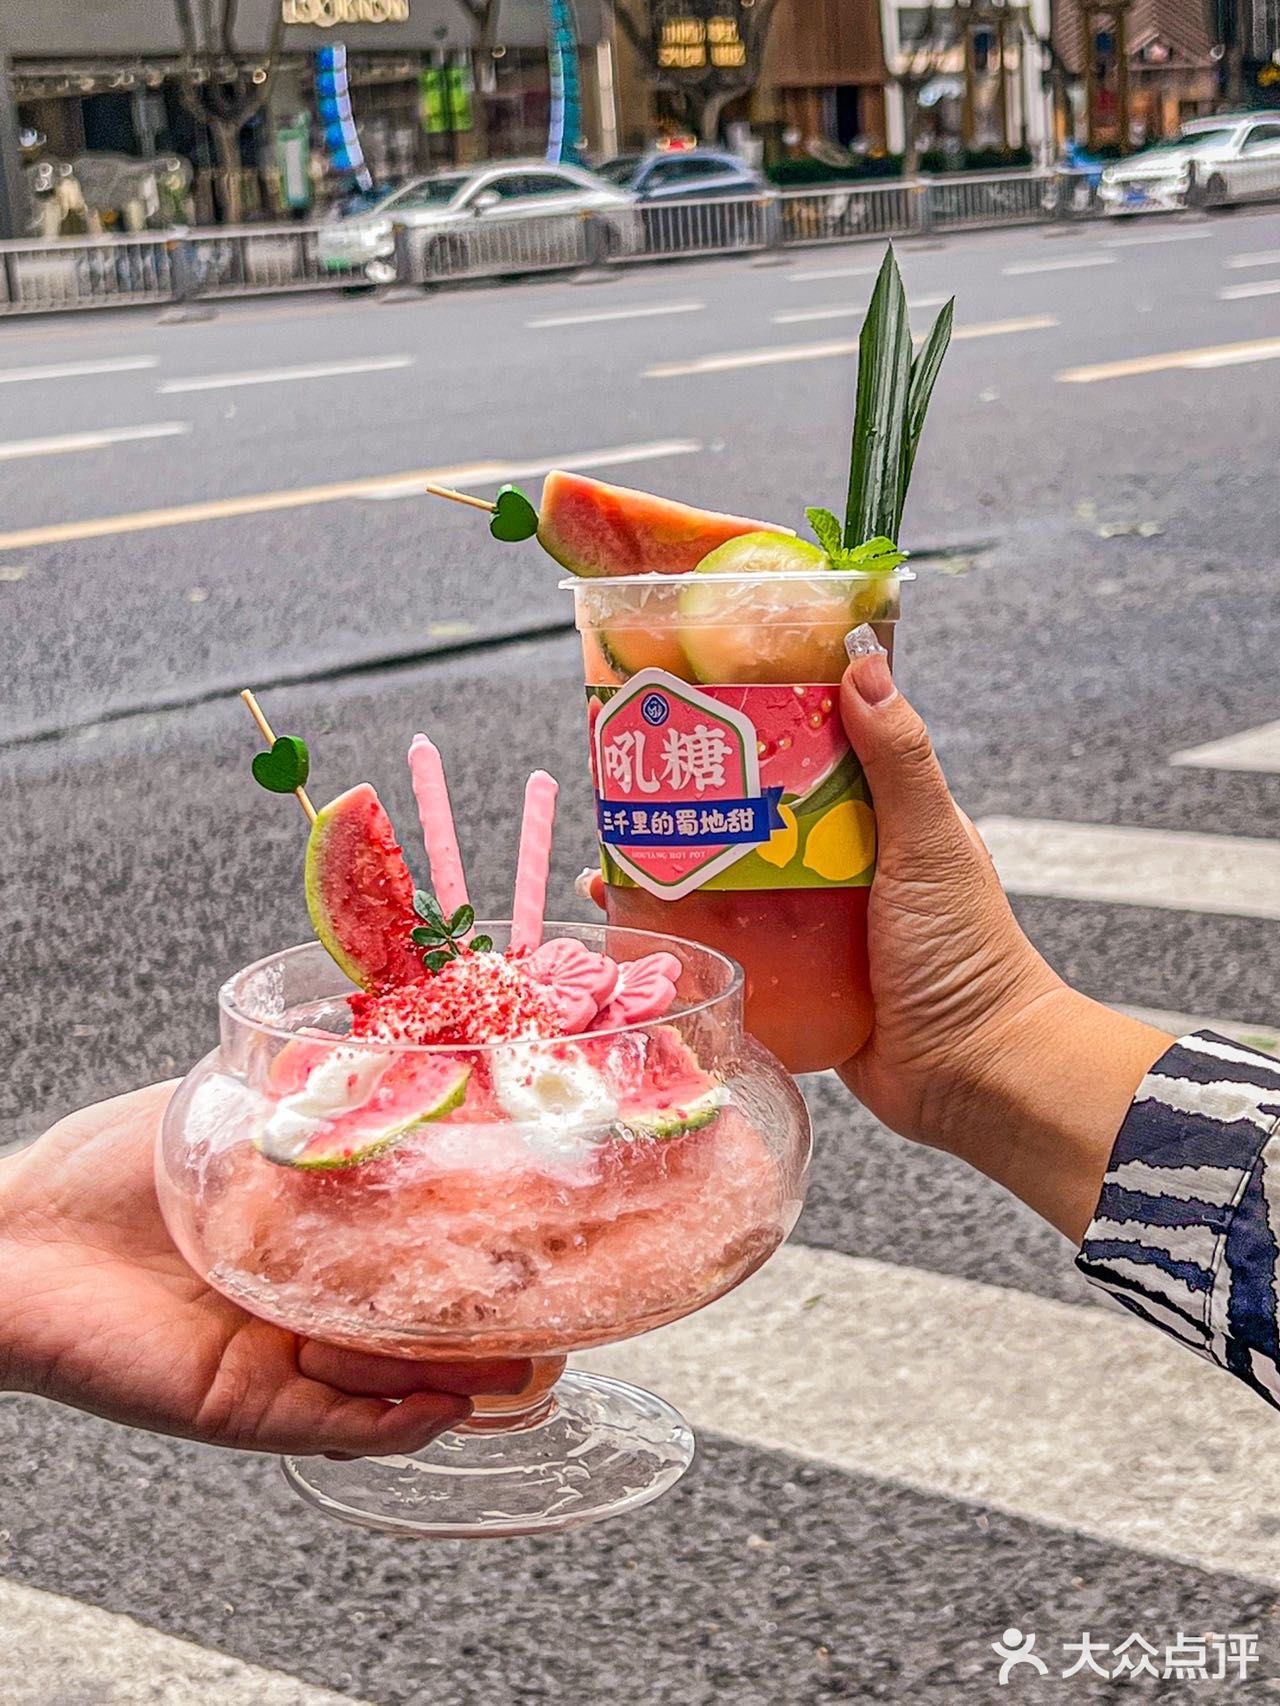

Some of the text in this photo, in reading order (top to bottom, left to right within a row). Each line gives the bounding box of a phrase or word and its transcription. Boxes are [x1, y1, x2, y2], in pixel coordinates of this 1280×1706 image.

[604, 724, 733, 794] 吼糖
[603, 808, 755, 837] 三千里的蜀地甜
